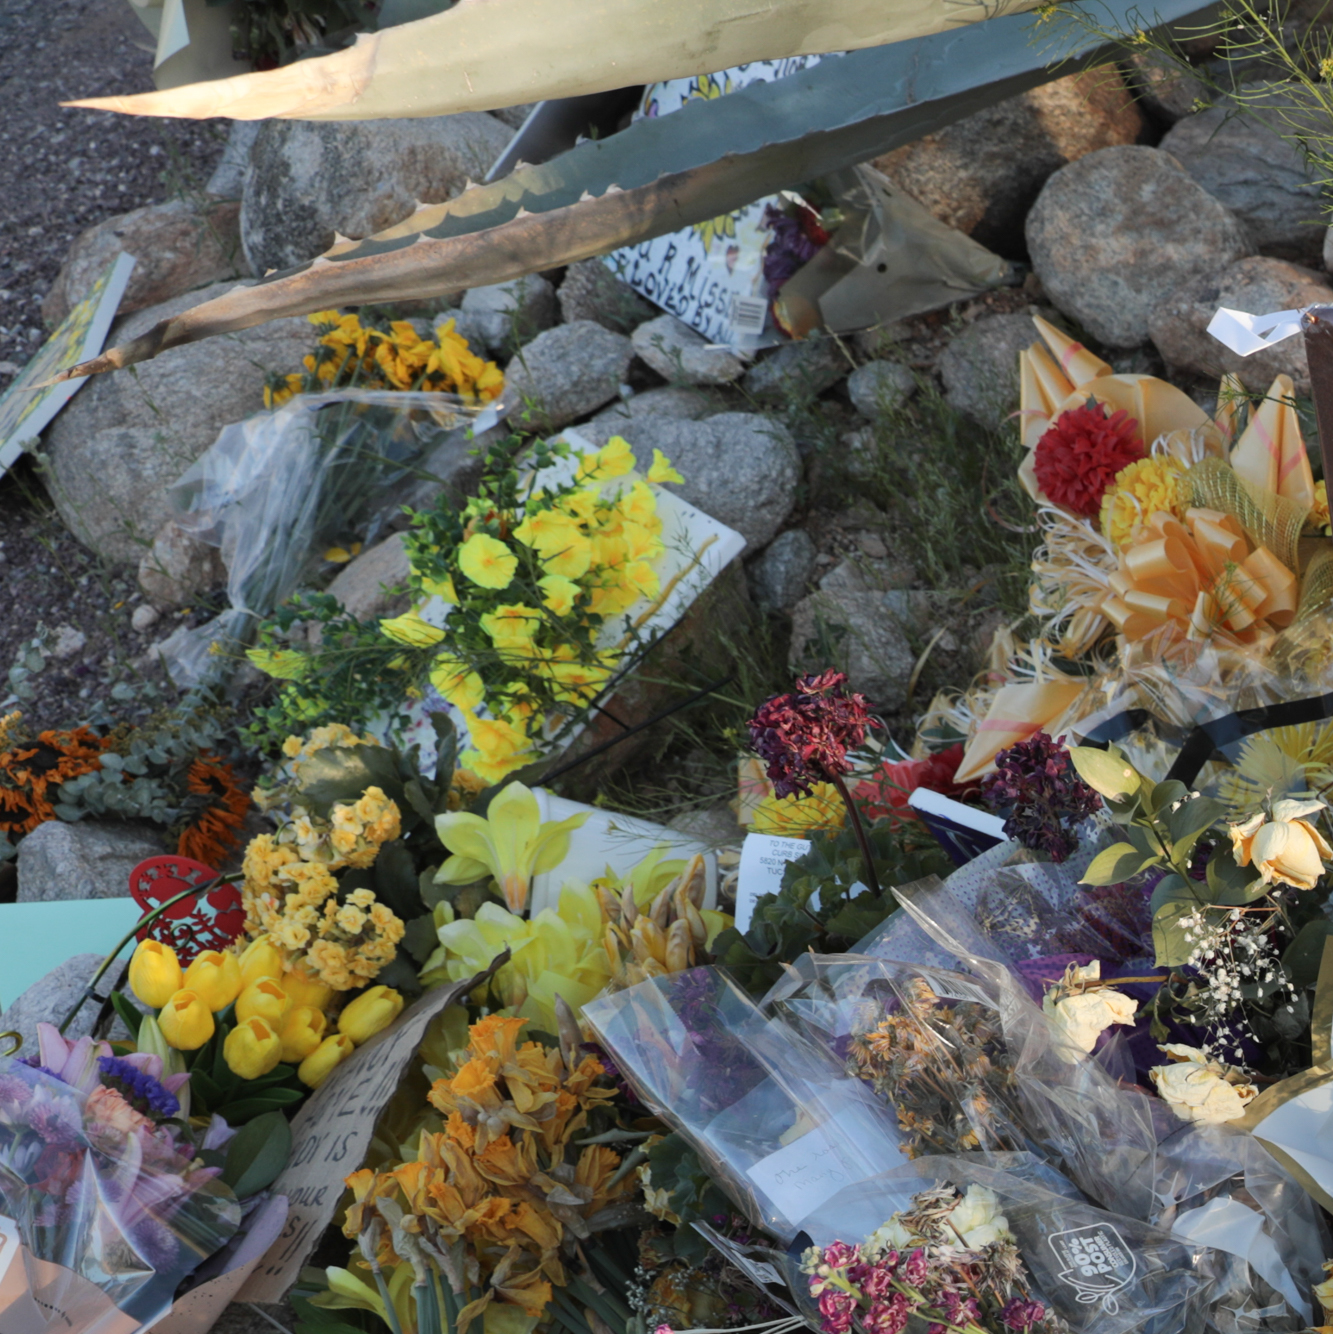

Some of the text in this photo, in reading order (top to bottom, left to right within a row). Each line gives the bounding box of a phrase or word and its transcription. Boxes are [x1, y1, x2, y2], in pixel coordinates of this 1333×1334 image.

[767, 867, 784, 876] TUC
[1069, 1237, 1099, 1277] 90%
[1079, 1237, 1113, 1274] POST
